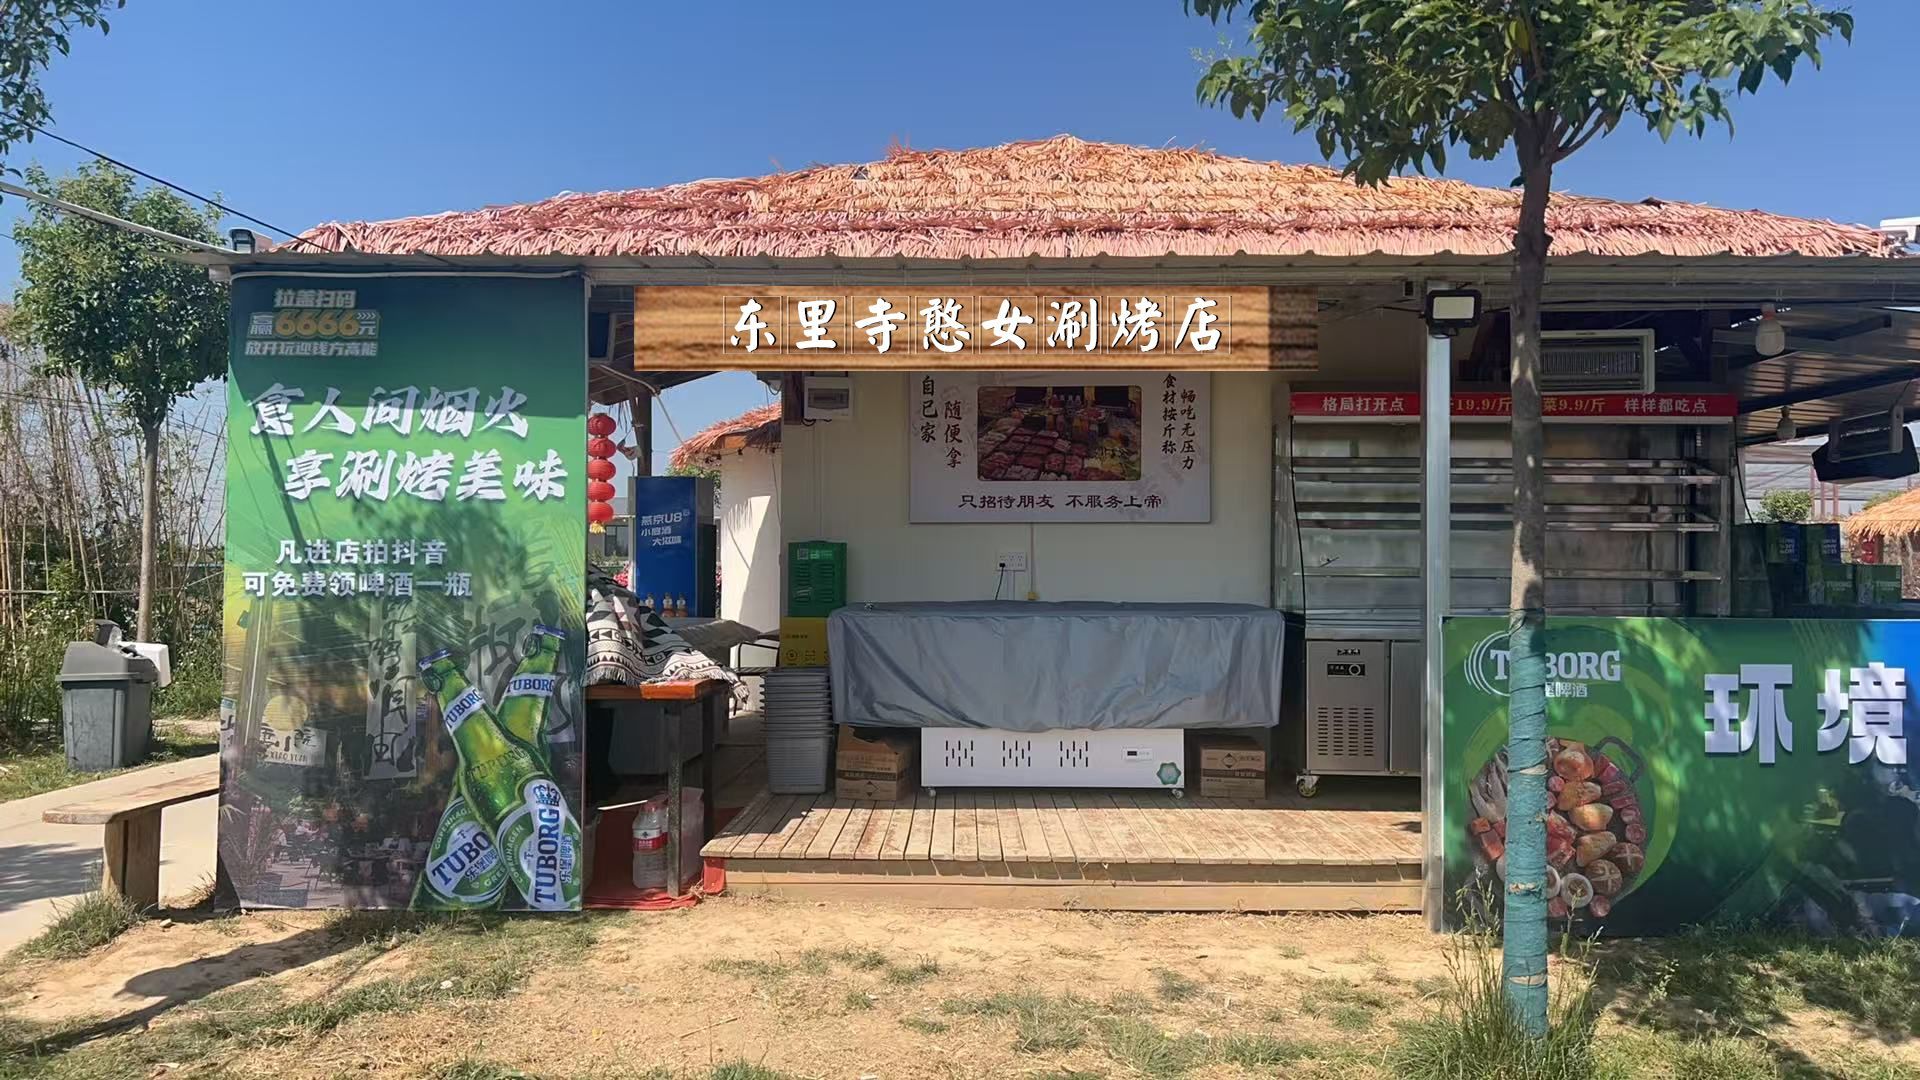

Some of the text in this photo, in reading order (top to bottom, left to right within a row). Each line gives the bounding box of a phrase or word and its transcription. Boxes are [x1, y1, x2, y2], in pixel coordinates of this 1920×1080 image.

[249, 311, 377, 336] 赢6666元
[273, 288, 357, 308] 拉盖扫码
[248, 383, 530, 438] 食人间烟火
[920, 375, 938, 443] 自己家
[1161, 373, 1178, 455] 食材按斤称
[1180, 388, 1197, 470] 畅吃无压力
[1322, 397, 1405, 413] 格局打开点
[1450, 397, 1512, 412] 19.9/斤
[1624, 397, 1708, 414] 样样都吃点
[944, 400, 963, 469] 随便拿
[284, 448, 569, 502] 享涮烤美味
[958, 494, 1162, 509] 只招待朋友 不服务上帝
[275, 539, 448, 565] 凡进店拍抖音
[242, 571, 473, 597] 可免费领啤酒一瓶
[1490, 649, 1621, 682] TBORG
[1703, 662, 1908, 765] 环境
[534, 804, 561, 903] TUBORG
